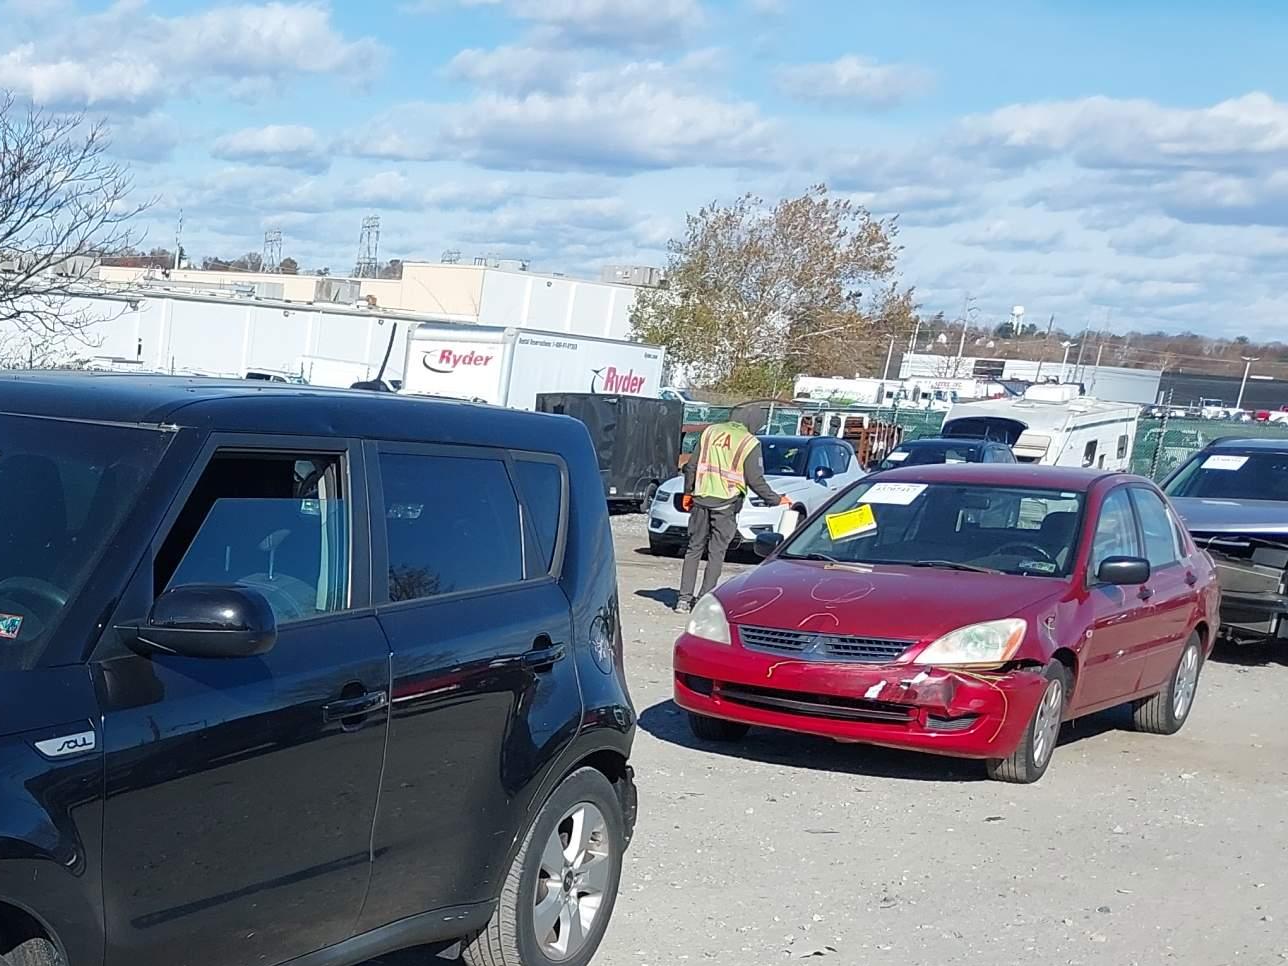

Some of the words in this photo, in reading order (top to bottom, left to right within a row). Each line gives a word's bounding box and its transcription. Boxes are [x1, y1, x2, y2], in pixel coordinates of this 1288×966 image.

[438, 349, 494, 368] Ryder
[603, 366, 646, 394] Ryder
[712, 432, 731, 450] IA
